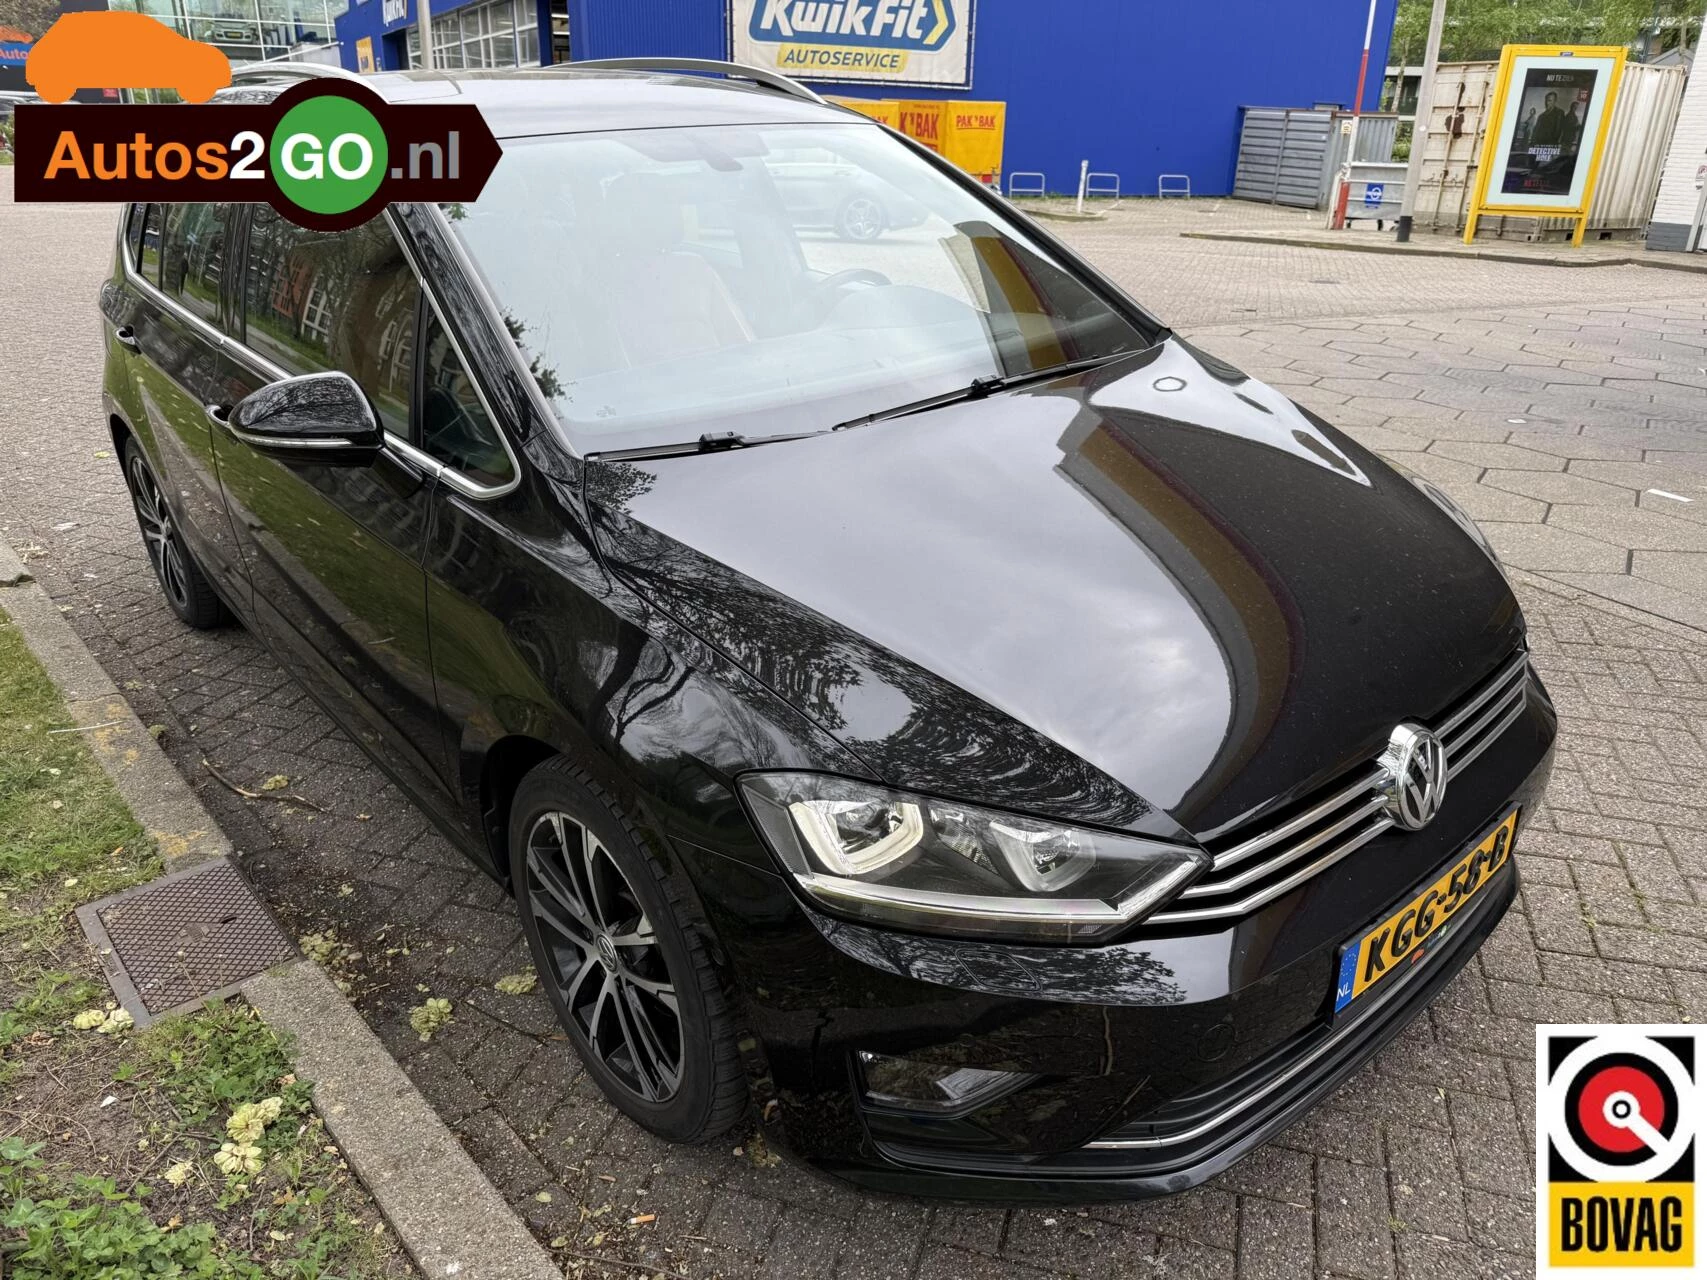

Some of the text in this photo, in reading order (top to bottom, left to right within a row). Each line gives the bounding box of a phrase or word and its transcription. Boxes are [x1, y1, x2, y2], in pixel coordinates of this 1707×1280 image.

[0, 48, 29, 60] Auto
[784, 48, 900, 69] AUTOSERVICE
[916, 112, 940, 140] BAK
[956, 115, 973, 127] PAK
[979, 115, 996, 128] BAK
[1364, 825, 1509, 982] KGG-58-B
[1337, 982, 1351, 1000] NL
